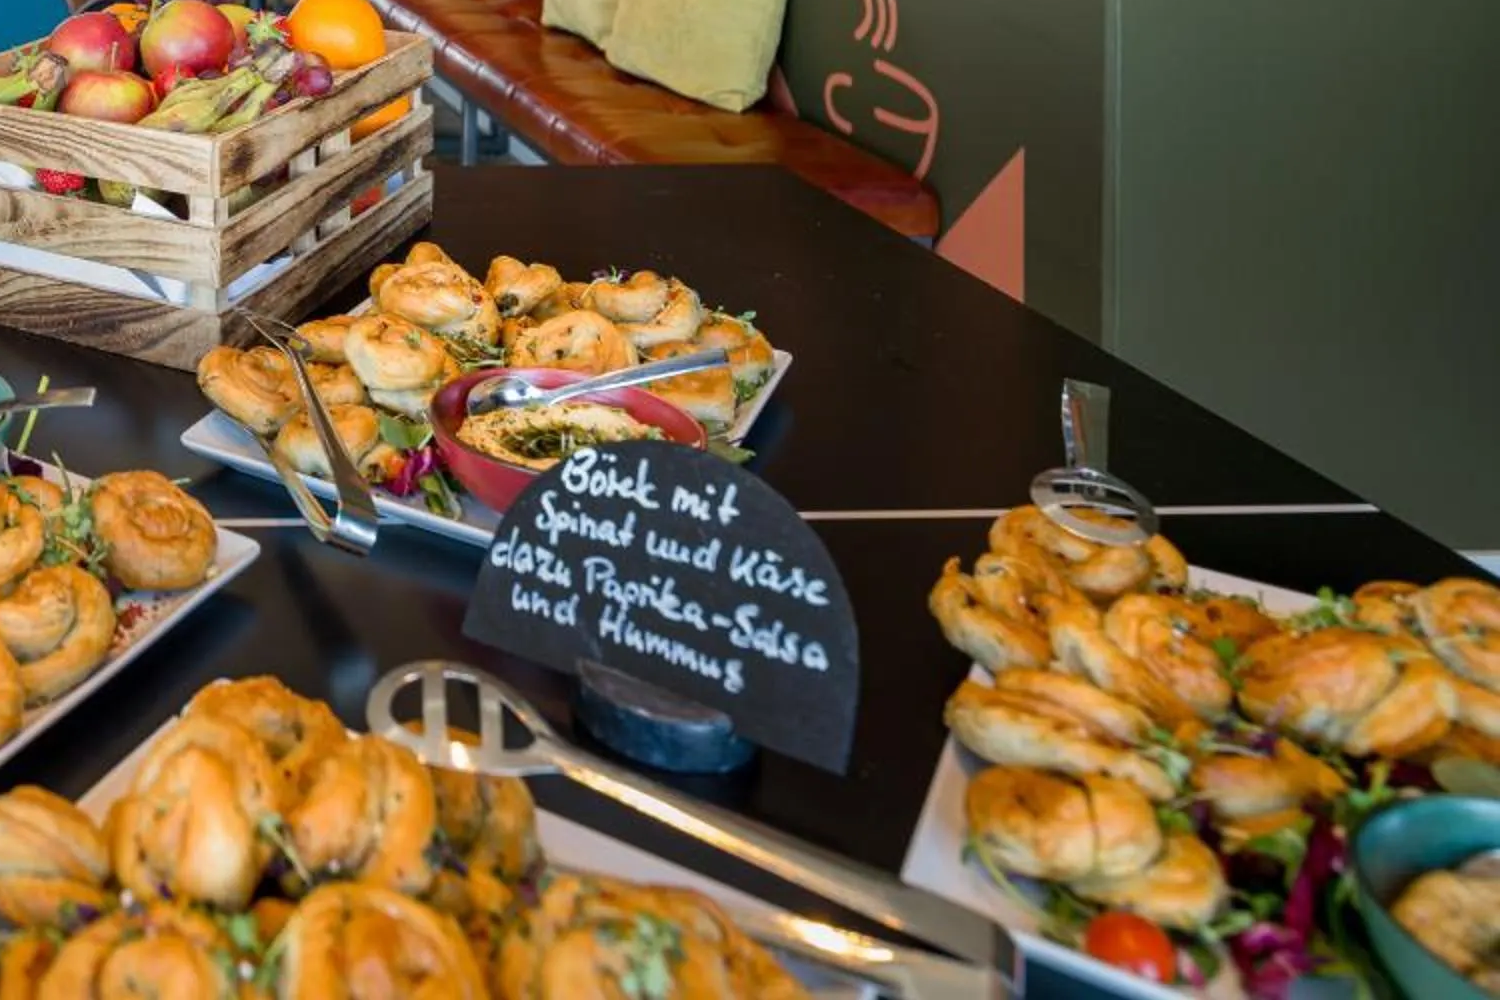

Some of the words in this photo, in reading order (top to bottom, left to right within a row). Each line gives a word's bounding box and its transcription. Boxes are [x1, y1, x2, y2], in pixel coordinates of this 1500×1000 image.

[561, 448, 659, 509] Börek
[671, 484, 740, 525] mit
[490, 528, 571, 588] dazu
[583, 556, 830, 672] Paprika-Salsa
[535, 490, 636, 545] Spinat
[645, 530, 721, 572] und
[729, 546, 830, 606] Käse
[511, 583, 579, 628] und
[599, 606, 745, 694] Hummus
